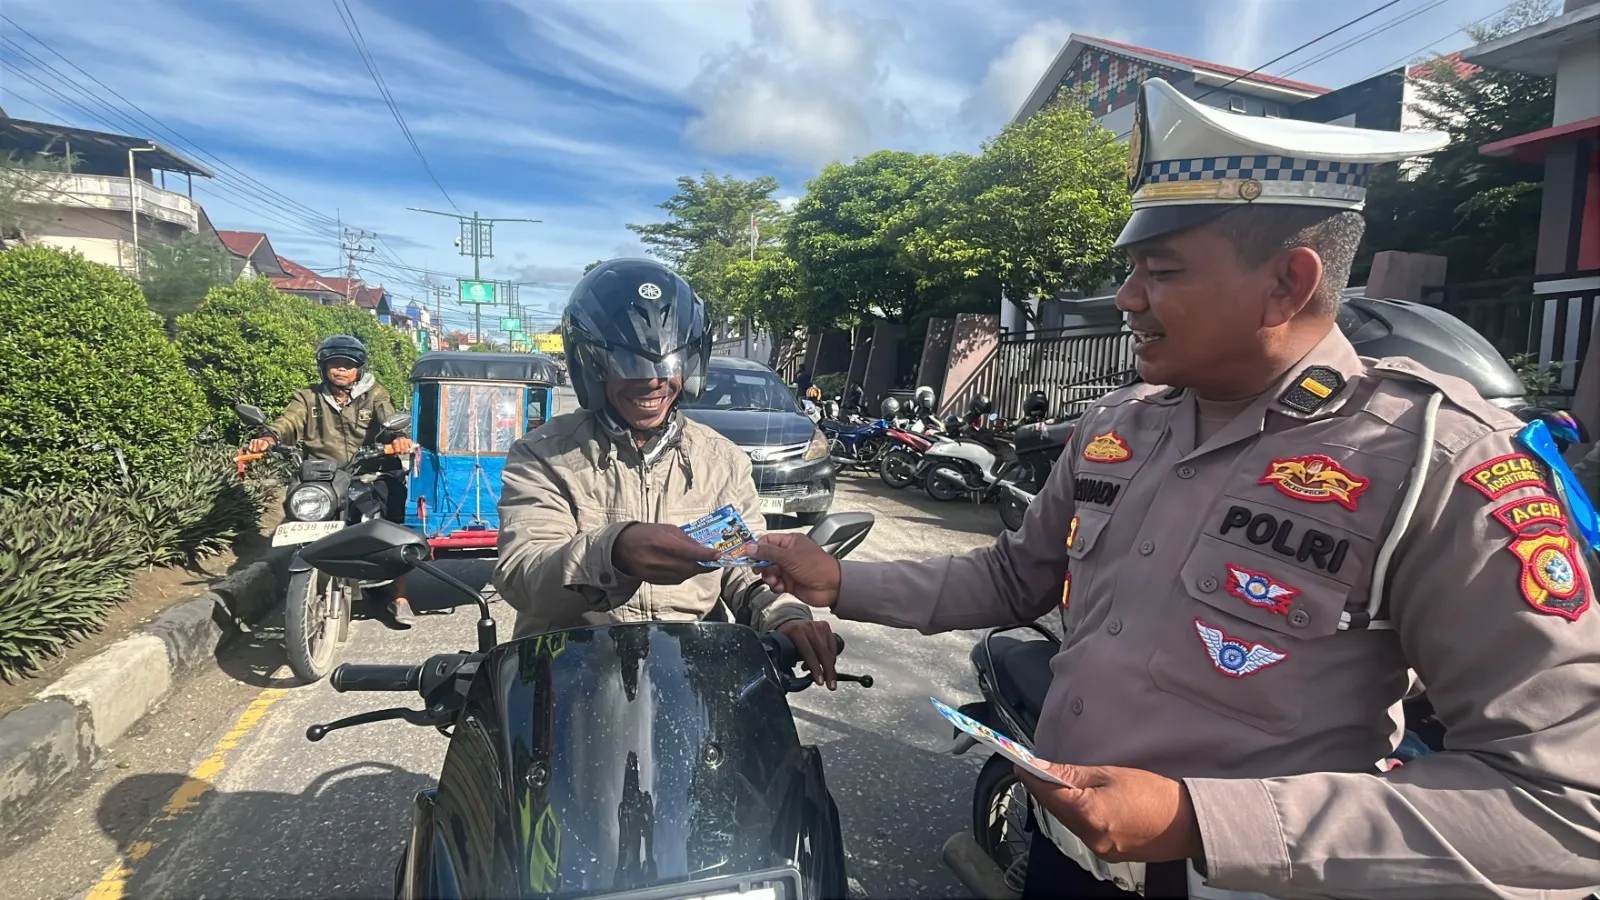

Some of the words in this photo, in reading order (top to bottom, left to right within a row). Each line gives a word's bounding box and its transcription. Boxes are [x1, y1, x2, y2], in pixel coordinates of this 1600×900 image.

[1511, 502, 1561, 524] ACEH
[278, 526, 288, 535] BL
[1219, 505, 1349, 574] POLRI
